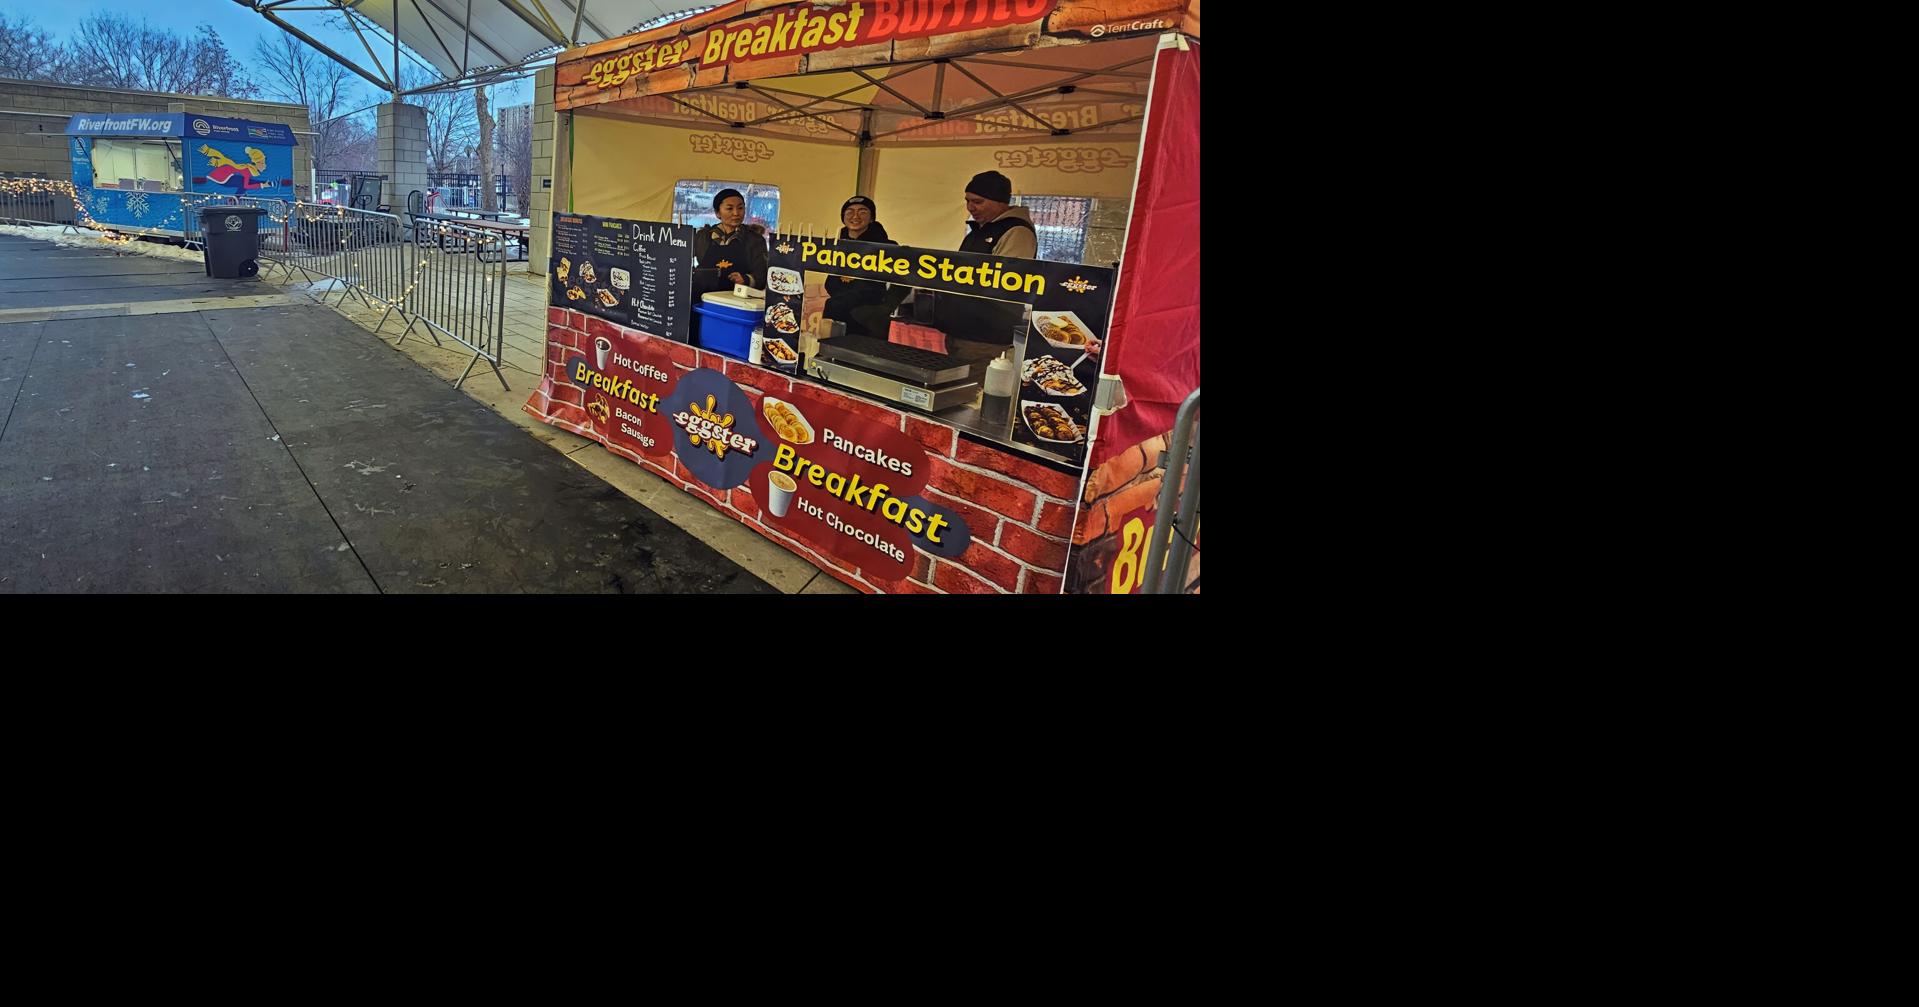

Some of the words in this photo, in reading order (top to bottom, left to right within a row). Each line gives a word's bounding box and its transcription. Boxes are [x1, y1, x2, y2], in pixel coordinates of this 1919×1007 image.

[582, 39, 691, 88] eggster
[703, 1, 864, 64] Breakfast
[867, 0, 1048, 38] Burrito
[1106, 18, 1164, 34] TentCraft
[78, 118, 172, 133] RiverfrontFW.org
[632, 223, 655, 242] Drink
[658, 226, 687, 247] Menu
[801, 242, 910, 276] Pancake
[917, 254, 1046, 296] Station
[575, 362, 660, 413] Breakfast
[613, 352, 632, 369] Hot
[633, 360, 668, 383] Coffee
[615, 407, 642, 426] Bacon
[621, 423, 655, 447] Sausage
[672, 410, 757, 454] eggster
[823, 428, 913, 476] Pancakes
[772, 443, 949, 543] Breakfast
[797, 496, 824, 521] Hot
[826, 513, 905, 563] Chocolate
